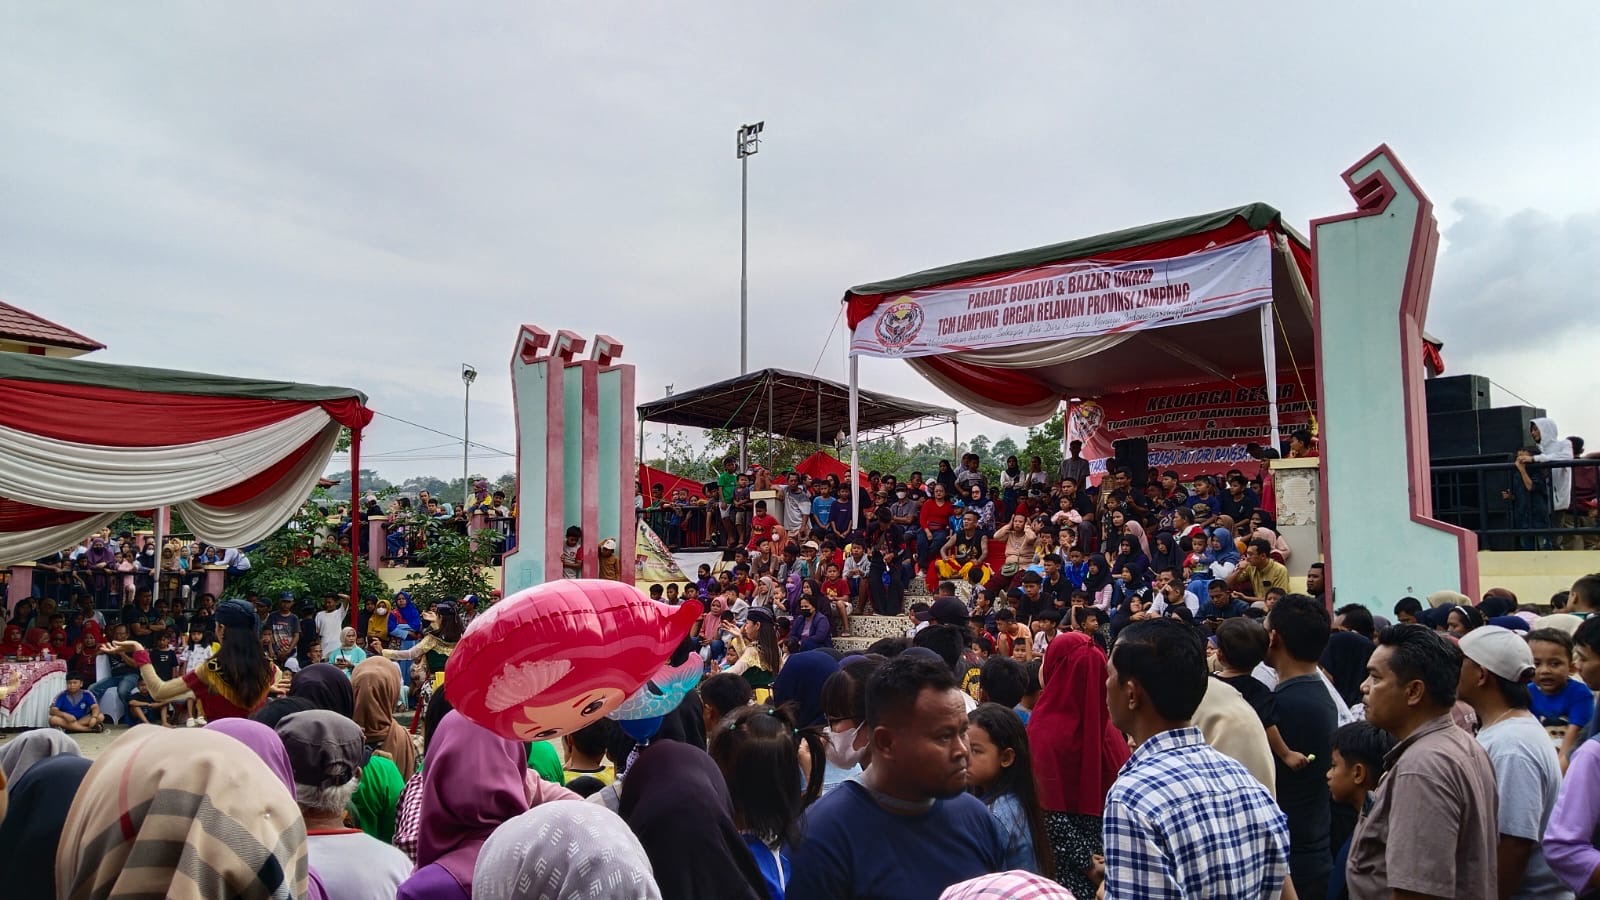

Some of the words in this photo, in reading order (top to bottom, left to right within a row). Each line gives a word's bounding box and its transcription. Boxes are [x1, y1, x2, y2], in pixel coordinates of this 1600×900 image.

[968, 287, 1008, 310] PARADE
[1010, 280, 1053, 302] BUDAYA
[1056, 280, 1065, 295] &
[1068, 271, 1111, 294] BAZZAR
[938, 316, 956, 336] TCM
[957, 309, 999, 333] LAMPUNG
[1002, 303, 1035, 326] ORGAN
[1037, 295, 1085, 321] RELAWAN
[1087, 290, 1135, 315] PROVINSI
[1136, 282, 1190, 308] LAMPUNG
[1147, 390, 1232, 412] KELUARGA
[1236, 384, 1295, 403] BESR
[1163, 409, 1196, 424] CIPTO
[1206, 420, 1216, 428] &
[1148, 430, 1201, 445] RELAWAN
[1203, 427, 1260, 441] PROVINSI
